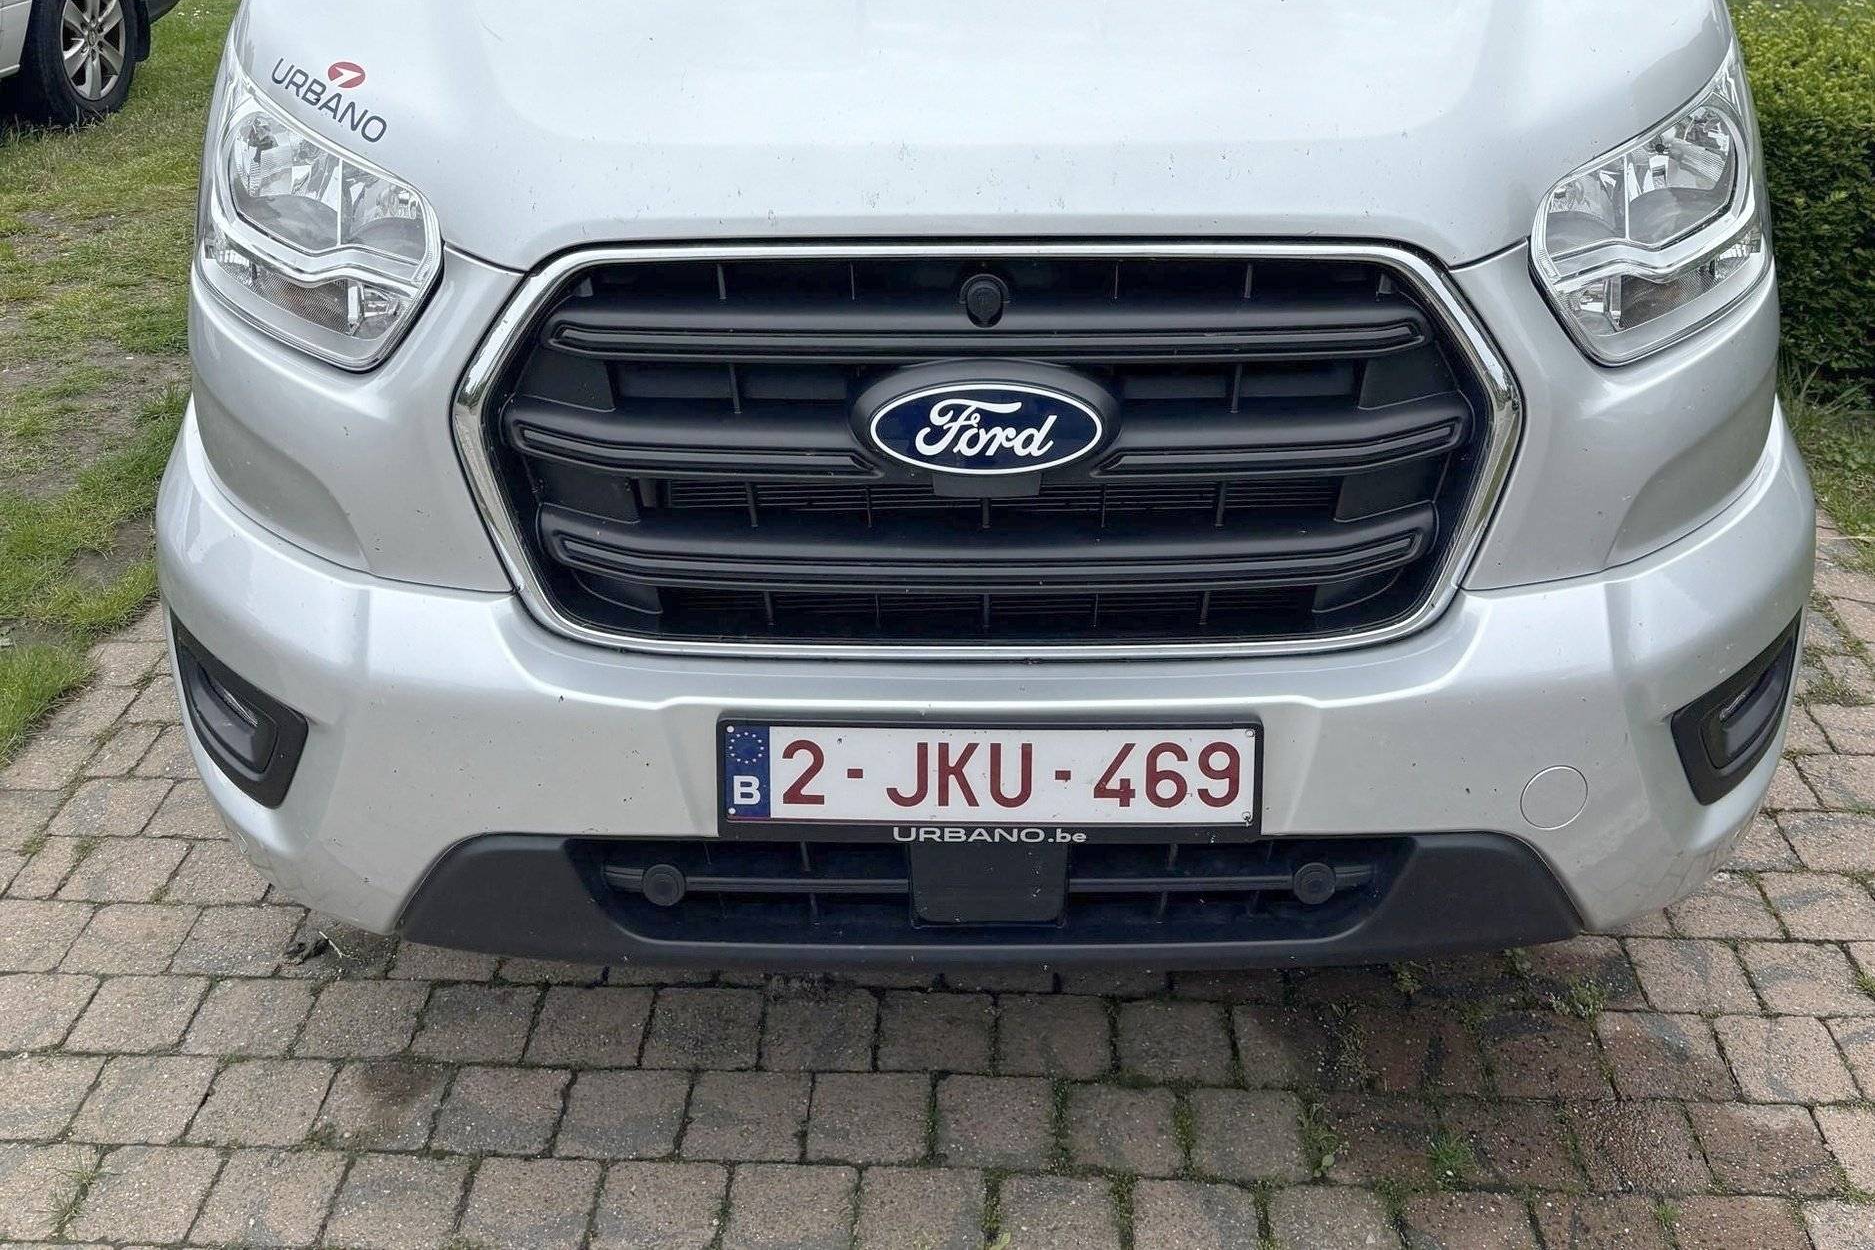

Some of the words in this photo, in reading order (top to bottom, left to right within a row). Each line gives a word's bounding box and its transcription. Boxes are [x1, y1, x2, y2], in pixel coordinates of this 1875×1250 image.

[271, 58, 387, 143] URBANO
[915, 398, 1057, 457] Ford
[733, 776, 761, 805] B
[893, 826, 1087, 844] URBANO.be
